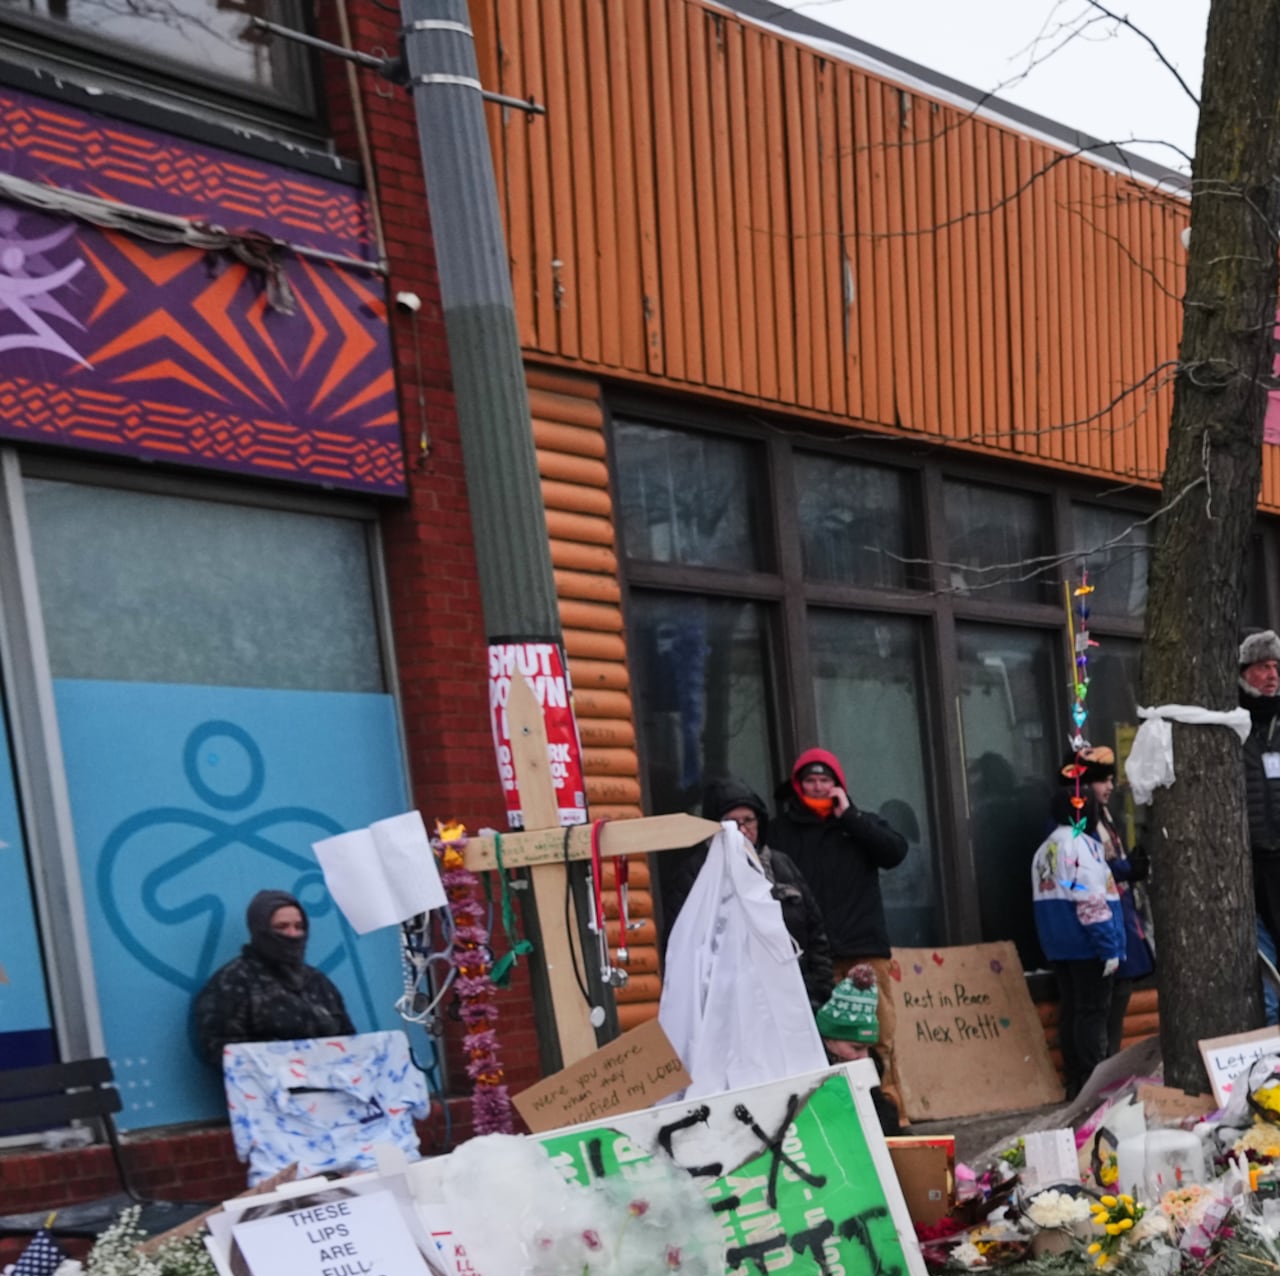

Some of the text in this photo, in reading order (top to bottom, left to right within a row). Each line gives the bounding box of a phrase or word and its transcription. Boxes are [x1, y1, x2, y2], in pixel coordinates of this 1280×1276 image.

[489, 643, 553, 677] SHUT
[904, 983, 992, 1008] Rest in Peace
[916, 1013, 1000, 1043] Alex Pretti
[576, 1068, 598, 1089] you
[603, 1044, 643, 1070] there
[1215, 1054, 1245, 1071] Let
[602, 1069, 626, 1088] they
[627, 1080, 647, 1096] my
[647, 1058, 683, 1085] LORD
[288, 1202, 352, 1227] THESE
[307, 1224, 349, 1244] LIPS
[319, 1242, 358, 1262] ARE
